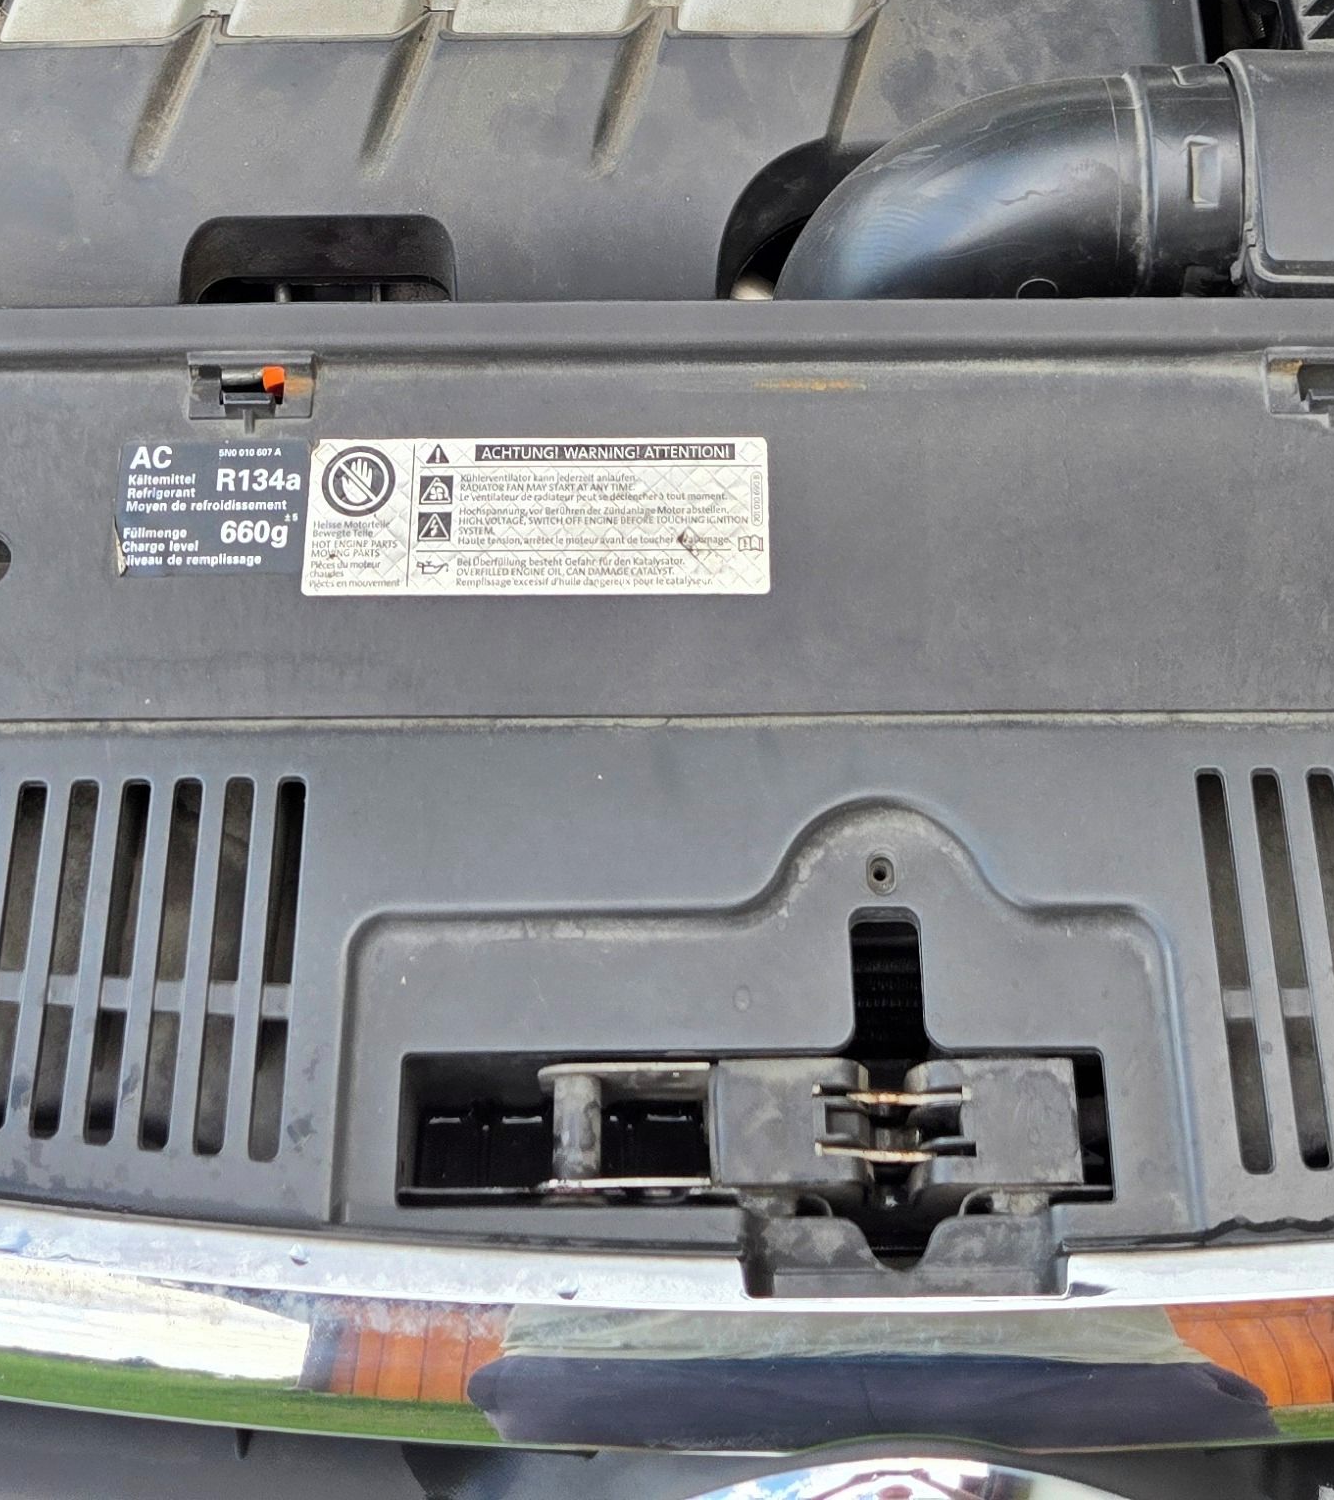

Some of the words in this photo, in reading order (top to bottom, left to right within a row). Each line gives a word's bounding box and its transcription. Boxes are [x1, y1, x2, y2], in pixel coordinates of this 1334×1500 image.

[130, 446, 173, 469] AC
[238, 448, 255, 457] 010
[274, 447, 282, 456] A
[481, 446, 559, 460] ACHTUNG!
[563, 446, 640, 459] WARNING!
[644, 445, 730, 459] ATTENTION!
[128, 473, 196, 486] Kältemittel
[216, 468, 302, 492] R134a
[460, 473, 531, 483] Kühlerventilator
[533, 473, 555, 482] kann
[557, 473, 594, 485] jederzeit
[127, 487, 196, 500] Refrigerant
[460, 483, 505, 492] RADIATOR
[506, 483, 524, 492] FAN
[526, 483, 546, 492] MAY
[548, 483, 575, 492] START
[576, 483, 588, 492] AT
[589, 483, 608, 492] ANY
[459, 493, 470, 502] Le
[472, 492, 518, 501] ventilateur
[520, 493, 532, 501] de
[533, 492, 575, 501] radiateur
[576, 493, 597, 504] peut
[598, 493, 608, 501] se
[666, 492, 685, 500] tout
[687, 492, 728, 500] moment.
[125, 501, 167, 514] Moyen
[171, 500, 187, 512] de
[190, 499, 287, 512] refroidissement
[529, 508, 543, 516] vor
[545, 506, 585, 516] Berühren
[587, 506, 601, 515] der
[657, 506, 685, 515] Motor
[344, 520, 390, 529] Motorteile
[458, 516, 482, 526] HIGH
[485, 516, 526, 527] VOLTAGE,
[528, 516, 563, 526] SWITCH
[565, 516, 582, 525] OFF
[584, 516, 618, 525] ENGINE
[620, 516, 654, 525] BEFORE
[656, 516, 705, 525] TOUCHING
[706, 515, 749, 524] IGNITION
[123, 527, 187, 541] Füllmenge
[220, 520, 289, 549] 660g
[312, 529, 351, 539] Bewegte
[353, 529, 373, 538] Teile
[311, 540, 331, 549] HOT
[334, 540, 368, 549] ENGINE
[371, 540, 398, 549] PARTS
[458, 536, 485, 546] Haute
[487, 536, 522, 547] tension,
[556, 536, 563, 545] le
[566, 536, 598, 545] moteur
[600, 536, 625, 545] avant
[627, 535, 638, 544] de
[640, 534, 674, 544] toucher
[122, 541, 165, 554] Charge
[169, 540, 199, 552] level
[353, 549, 381, 558] PARTS
[167, 553, 183, 566] de
[186, 553, 262, 568] remplissage
[337, 560, 348, 569] du
[350, 560, 381, 569] moteur
[457, 557, 471, 567] Bei
[473, 556, 527, 569] Überfüllung
[529, 557, 563, 567] besteht
[565, 557, 596, 566] Gefahr
[599, 557, 612, 566] für
[616, 557, 631, 566] den
[633, 556, 685, 567] Katalysator.
[309, 569, 344, 578] chaudes
[456, 567, 509, 577] OVERFILLED
[511, 567, 545, 576] ENGINE
[566, 567, 586, 576] CAN
[588, 567, 628, 576] DAMAGE
[336, 580, 347, 588] en
[348, 579, 400, 588] mouvement
[456, 577, 511, 588] Remplissage
[513, 577, 548, 586] excessif
[551, 577, 581, 586] d'huile
[583, 578, 630, 588] dangereux
[633, 578, 654, 587] pour
[656, 577, 664, 586] le
